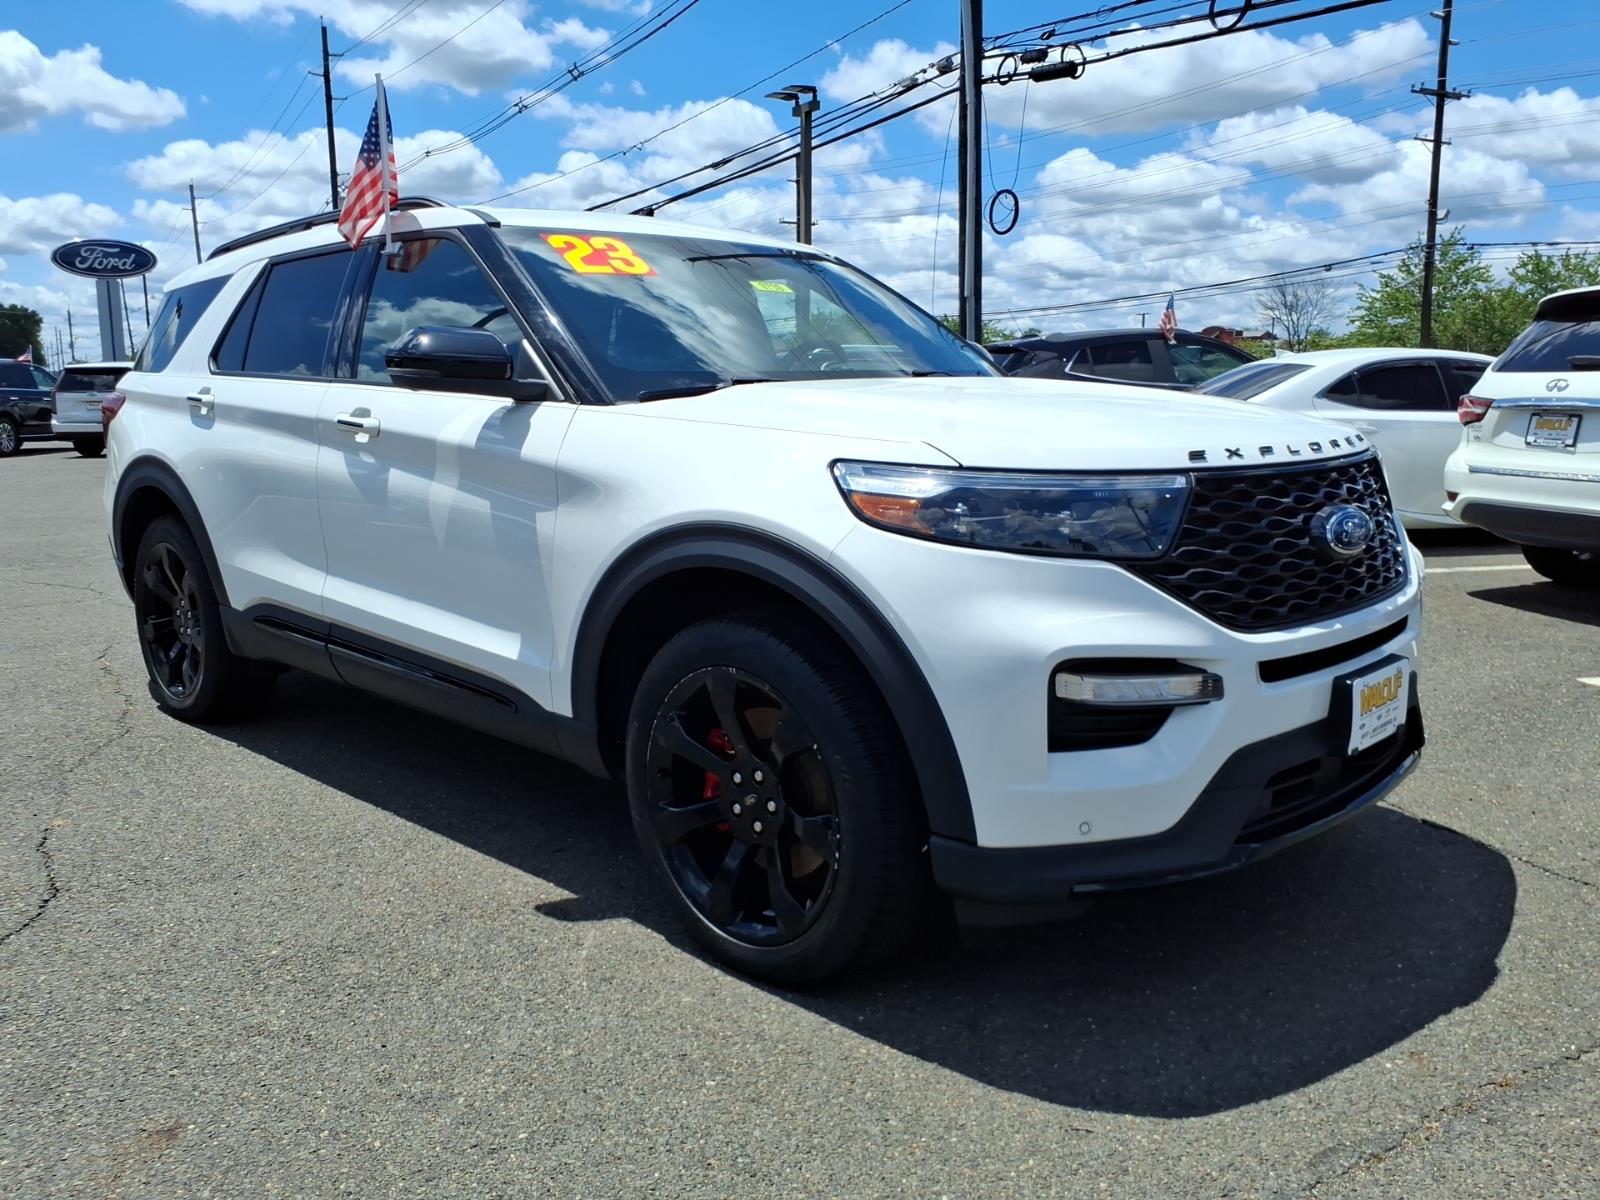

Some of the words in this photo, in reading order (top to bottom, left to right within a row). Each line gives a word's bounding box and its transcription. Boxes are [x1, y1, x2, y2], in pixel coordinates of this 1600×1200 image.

[75, 246, 136, 270] Ford
[547, 235, 651, 274] 23
[1188, 434, 1364, 462] EXPLORER
